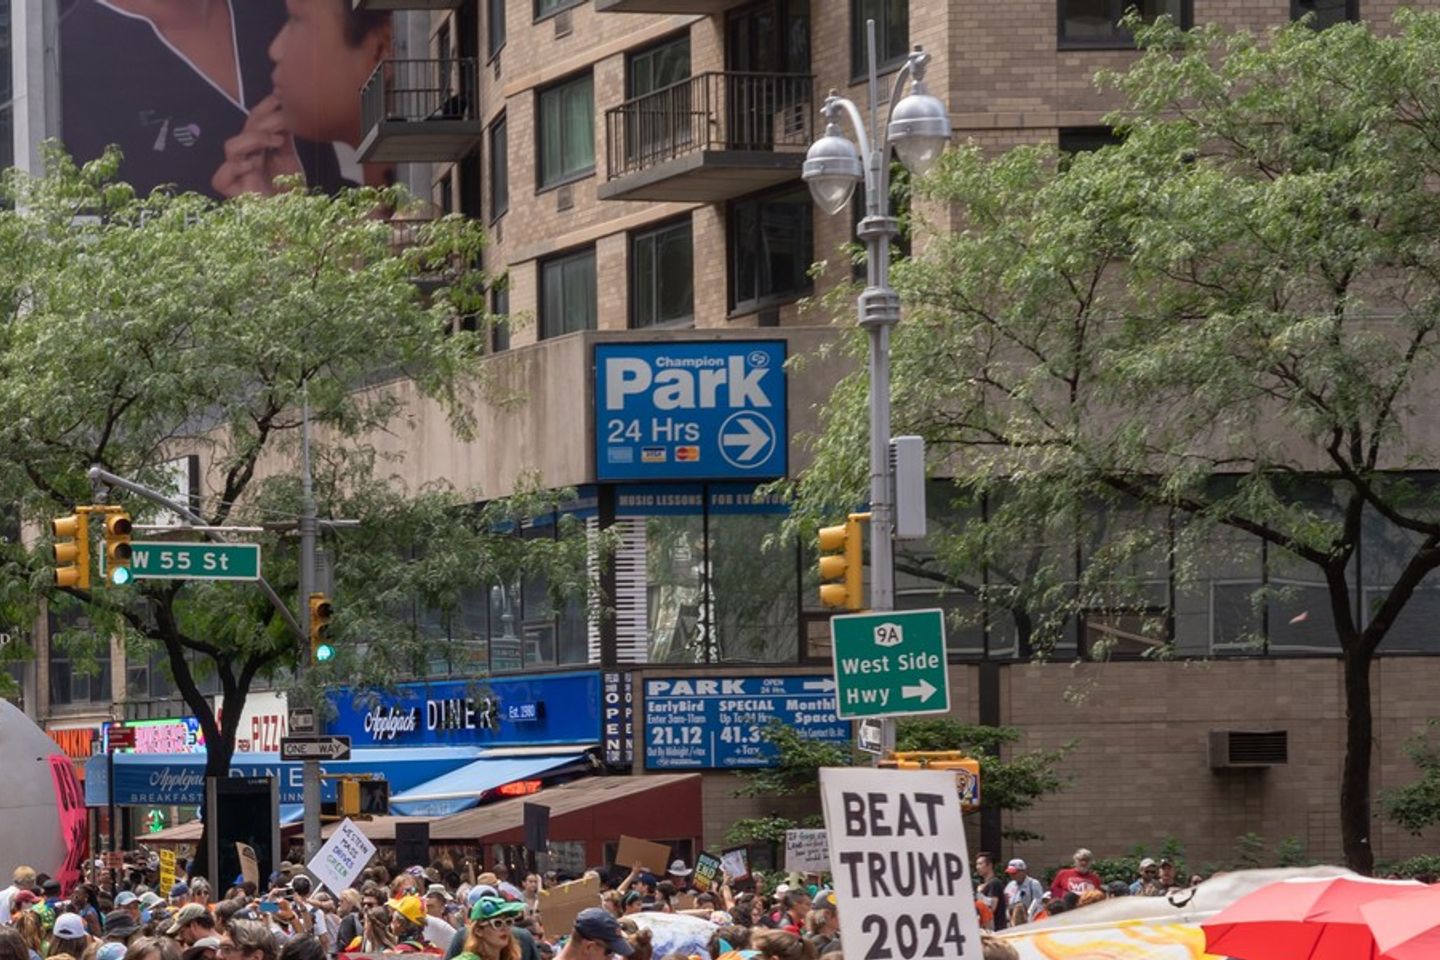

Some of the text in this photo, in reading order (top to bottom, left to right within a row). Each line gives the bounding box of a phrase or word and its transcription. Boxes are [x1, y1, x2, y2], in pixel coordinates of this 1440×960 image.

[655, 356, 725, 369] Champion
[606, 355, 773, 411] Park
[608, 417, 700, 443] 24 Hrs
[619, 494, 703, 506] MUSIC LESSONS
[713, 494, 735, 505] FOR
[133, 551, 229, 571] W 55 St
[877, 627, 899, 642] 9A
[842, 651, 939, 675] West Side
[648, 679, 745, 695] PARK
[648, 699, 835, 713] EarlyBird SPECIAL Monthl
[846, 688, 890, 706] Hwy
[364, 706, 416, 740] Applejack
[427, 699, 492, 730] DINER
[606, 692, 620, 749] OPEN
[795, 713, 836, 725] Space
[652, 726, 769, 744] 21.12 41.3
[286, 742, 341, 756] ONE WAY
[131, 793, 204, 803] BREAKFAST
[842, 792, 944, 837] BEAT
[839, 850, 963, 898] TRUMP
[861, 911, 966, 960] 2024
